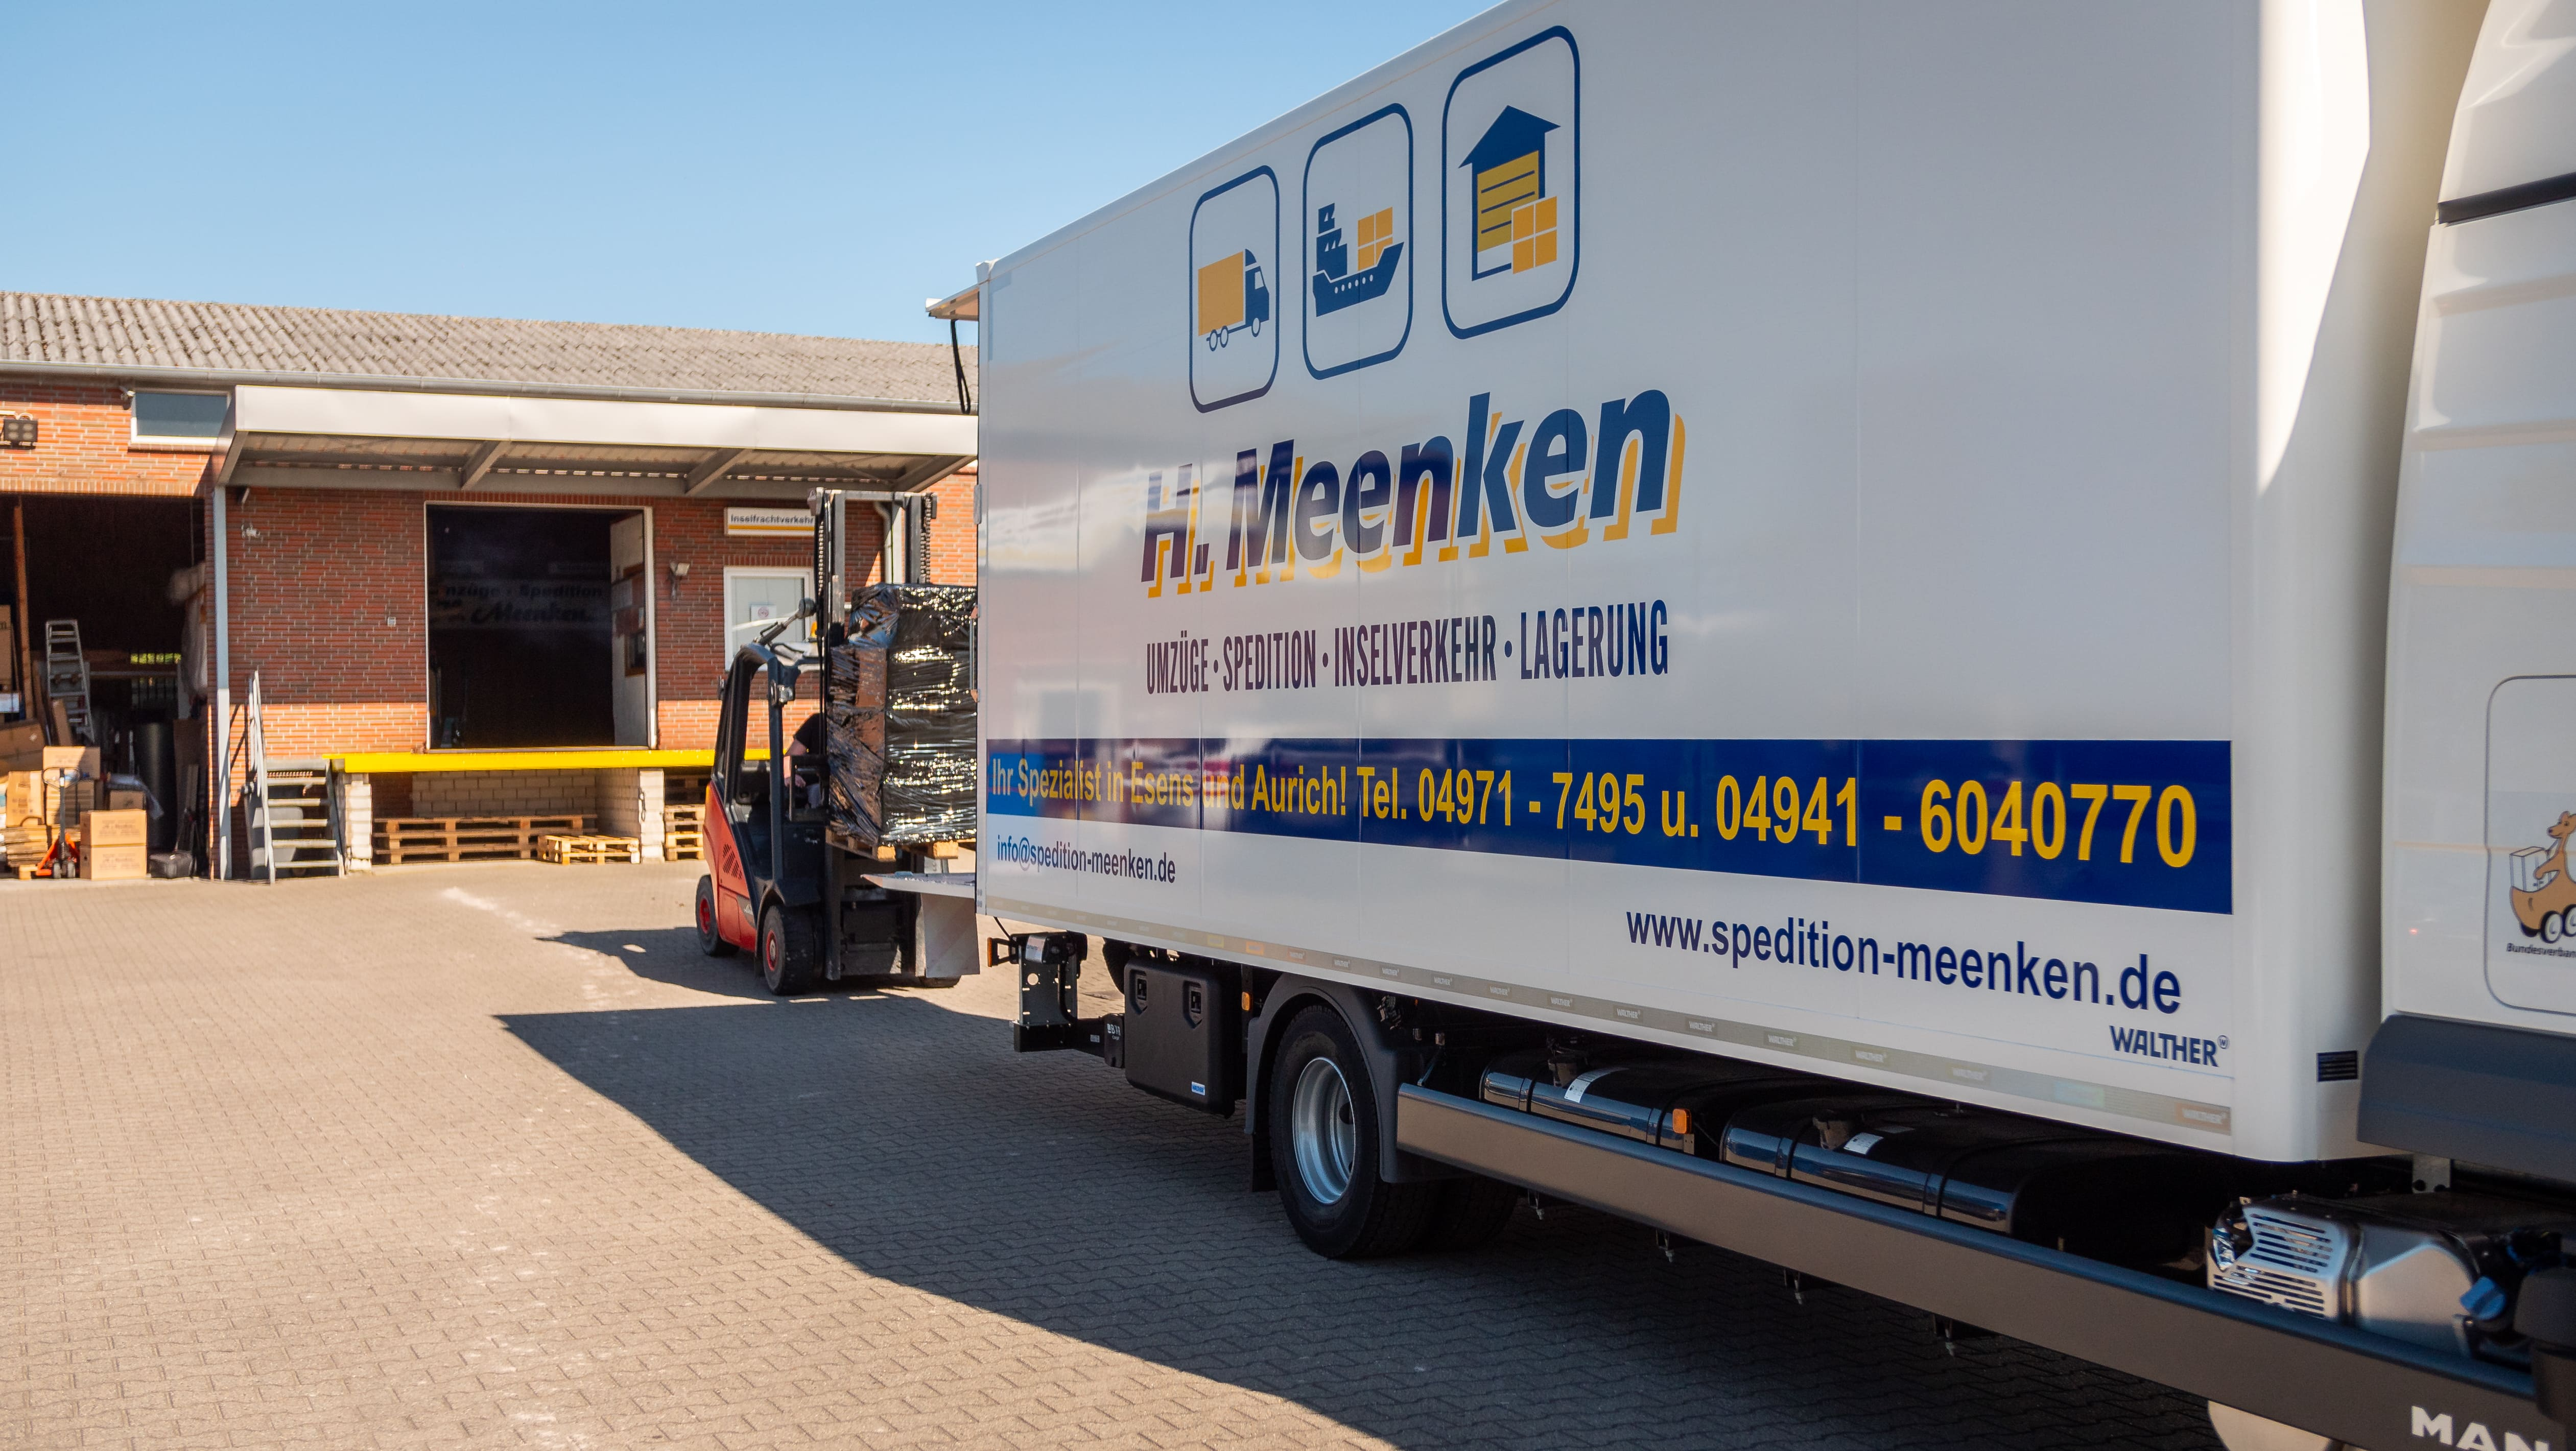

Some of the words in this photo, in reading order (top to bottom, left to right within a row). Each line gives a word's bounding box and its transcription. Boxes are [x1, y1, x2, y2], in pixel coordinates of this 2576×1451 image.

[731, 514, 813, 524] Inselfrachtverkehr
[1141, 463, 1215, 598] H.
[1226, 389, 1685, 587] Meenken
[1147, 630, 1209, 695] UMZÜGE
[1223, 630, 1316, 691] SPEDITION
[1335, 615, 1497, 687] INSELVERKEHR
[1521, 599, 1668, 680] LAGERUNG
[992, 758, 1013, 796] Ihr
[1018, 758, 1101, 806] Spezialist
[1107, 760, 1124, 802] in
[1131, 761, 1194, 807] Esens
[1202, 764, 1245, 810] und
[1251, 764, 1346, 816] Aurich!
[1357, 767, 1407, 819] Tel.
[1419, 768, 1511, 826] 04971
[1552, 772, 1645, 835] 7495
[1662, 790, 1698, 838] u.
[1716, 775, 1856, 847] 04941
[1921, 779, 2197, 868] 6040770
[997, 834, 1176, 884] info@spedition-meenken.de
[1626, 911, 2182, 1014] www.spedition-meenken.de
[2109, 1025, 2219, 1067] WALTHER
[2411, 1405, 2549, 1451] MAN
